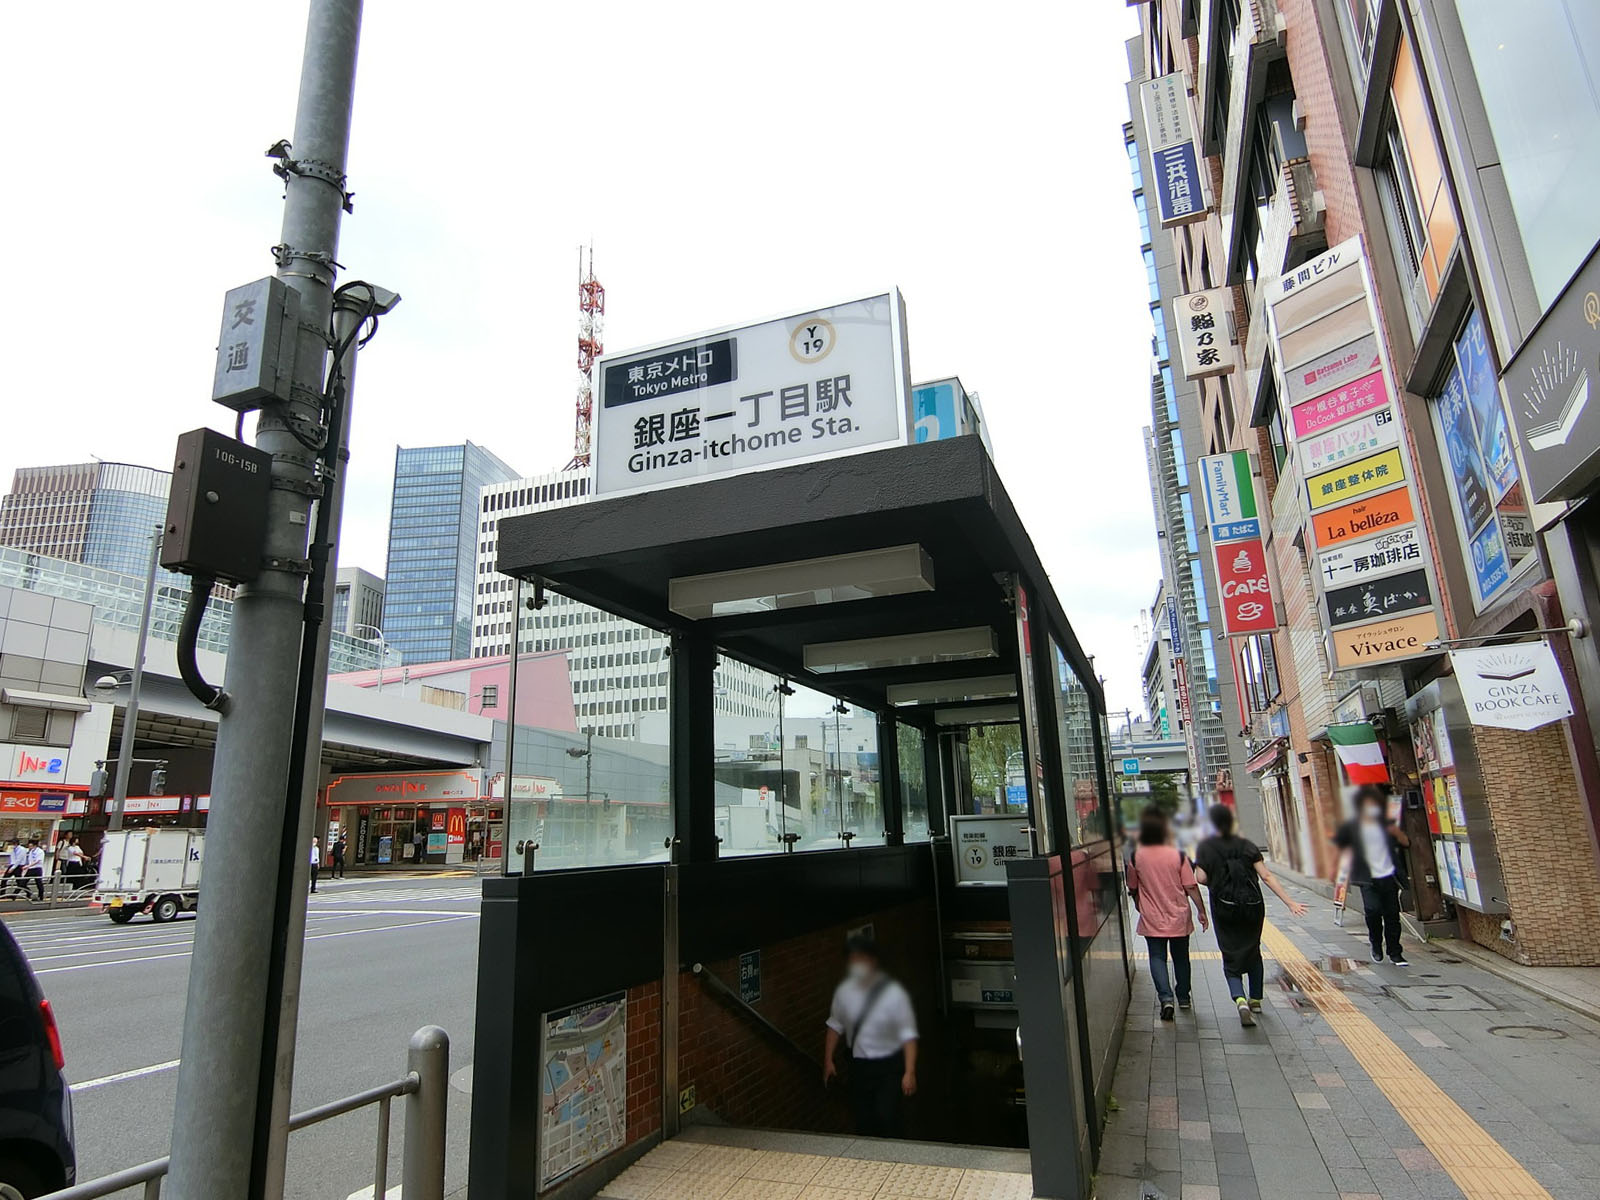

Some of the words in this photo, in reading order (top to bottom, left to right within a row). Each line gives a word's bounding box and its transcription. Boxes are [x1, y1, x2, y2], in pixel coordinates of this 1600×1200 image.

[1164, 147, 1192, 215] 三共消毒
[1282, 252, 1341, 292] 藤間ビル
[226, 298, 256, 374] 交通
[806, 326, 817, 338] Y
[804, 339, 824, 355] 19
[628, 350, 713, 384] 東京メトロ
[632, 381, 668, 397] Tokyo
[671, 371, 708, 390] Metro
[633, 374, 853, 450] 銀座一丁目駅
[1377, 411, 1392, 427] 9F
[628, 425, 802, 474] Ginza-itchome
[812, 415, 861, 439] Sta.
[1213, 460, 1231, 517] FamilyMart
[1322, 464, 1389, 496] 銀座整体院
[1353, 506, 1366, 515] hair
[1218, 526, 1230, 538] 酒
[1232, 524, 1255, 536] たばこ
[1328, 525, 1346, 540] La
[1350, 511, 1400, 533] belléza
[1323, 543, 1420, 580] 十一房珈琲店
[1350, 635, 1418, 658] Vivace
[1474, 694, 1521, 713] BOOK
[1522, 691, 1562, 707] CAFÉ
[1488, 684, 1541, 697] GINZA
[48, 758, 62, 774] 2
[4, 797, 37, 808] 宝くじ
[971, 856, 982, 865] 19
[992, 845, 1029, 858] 銀座一
